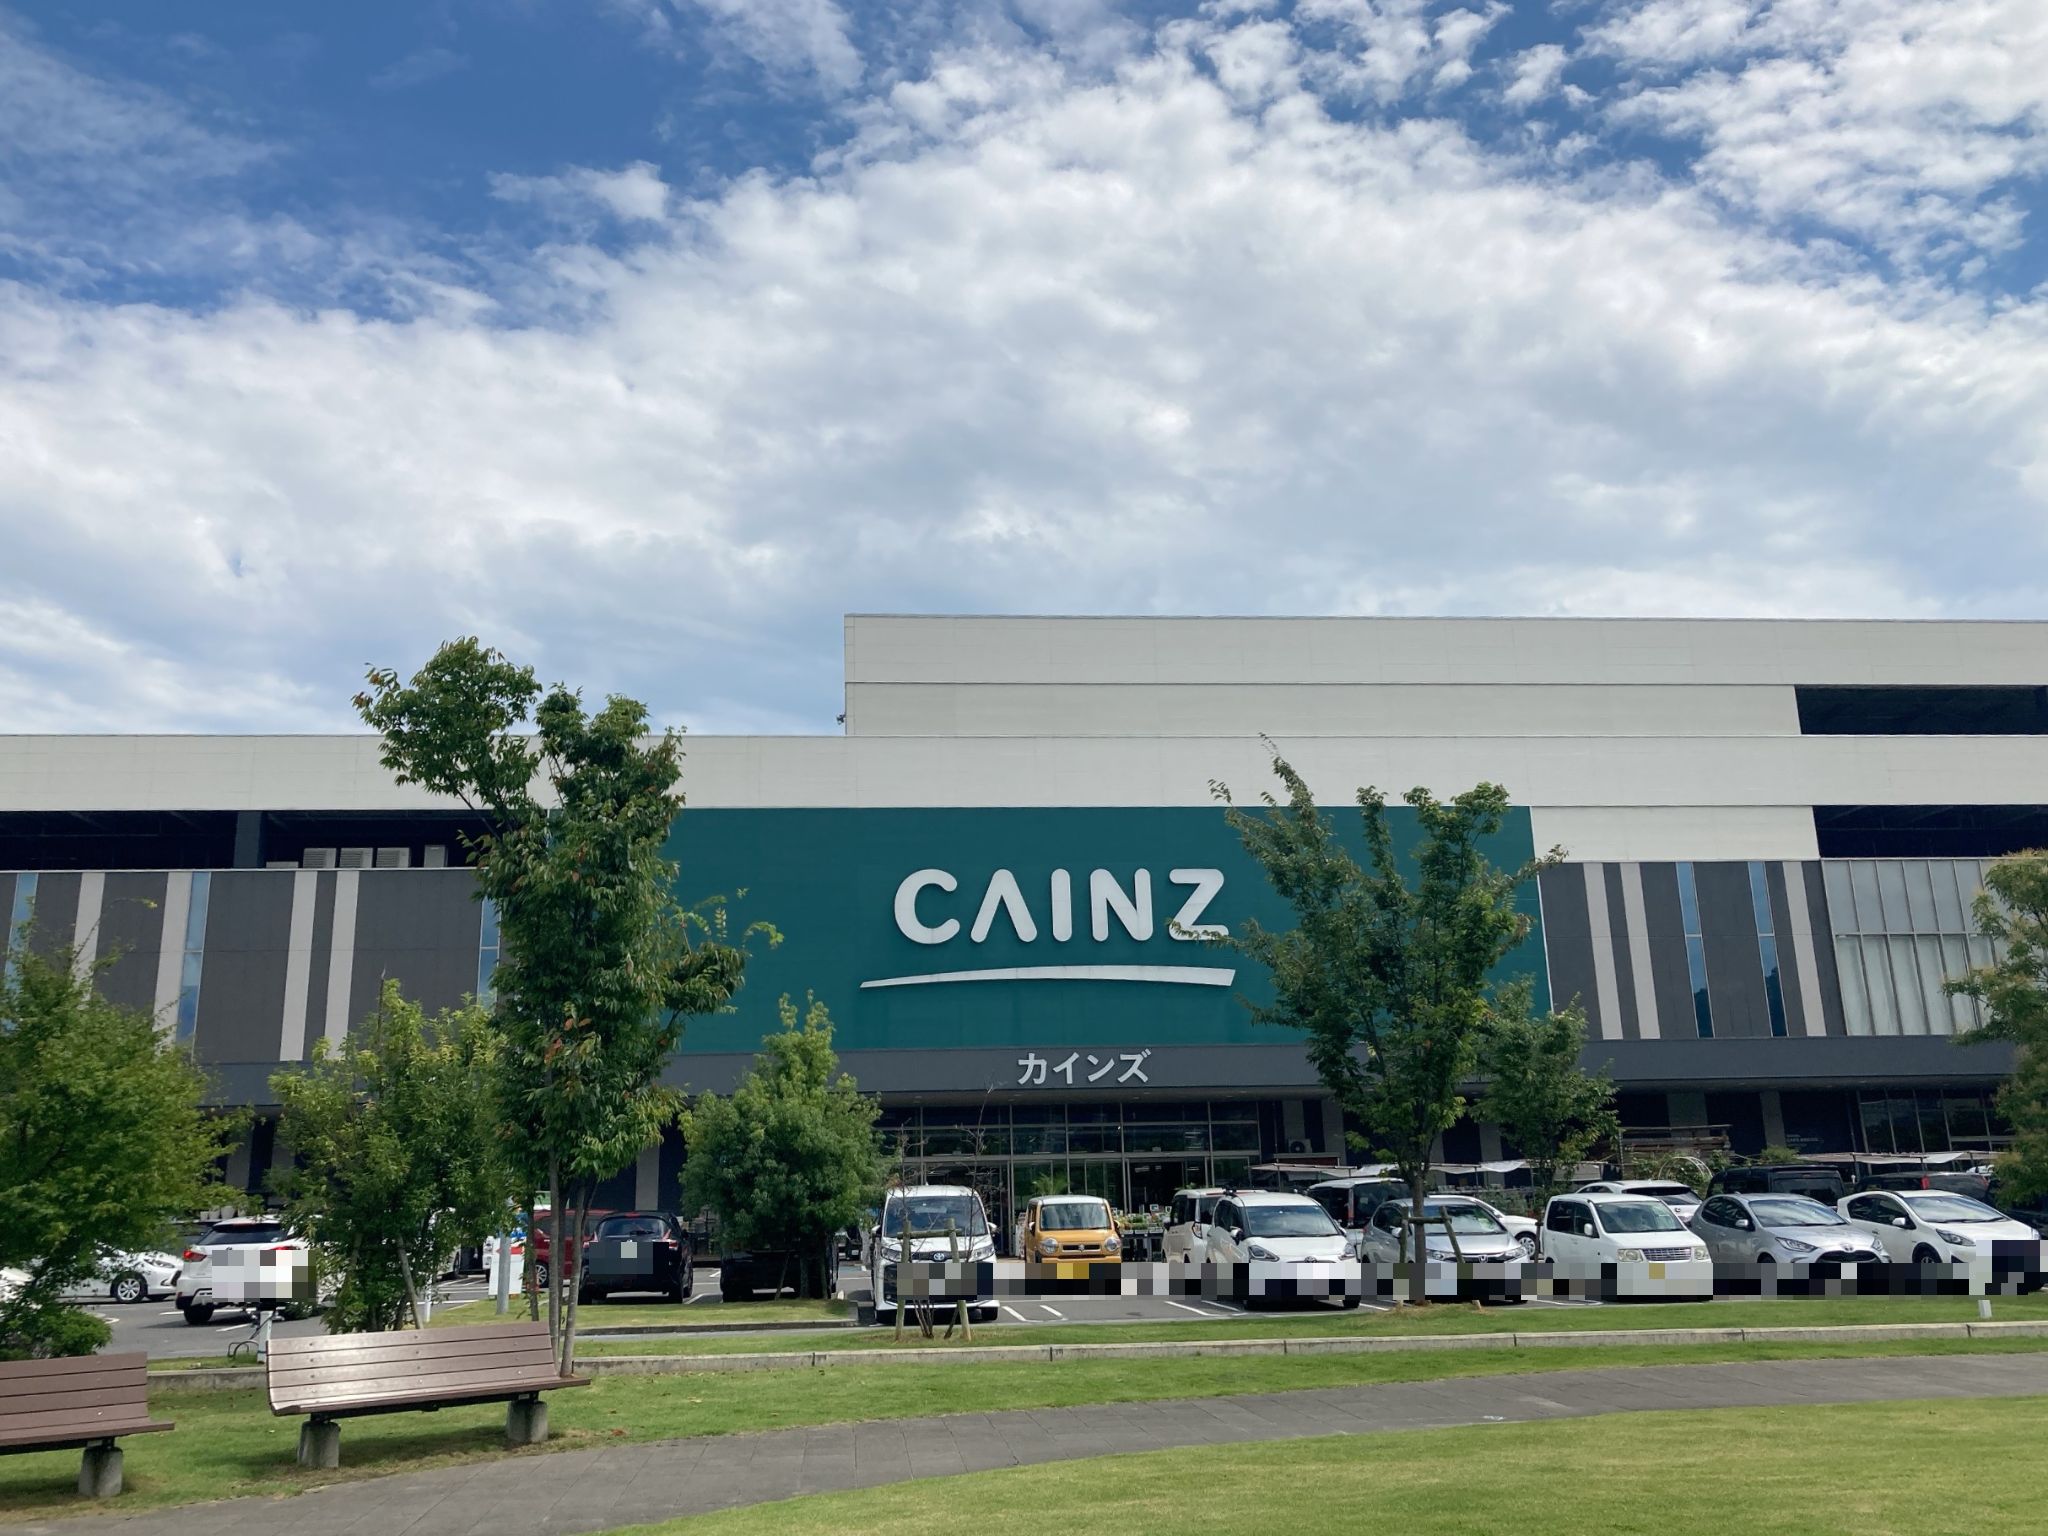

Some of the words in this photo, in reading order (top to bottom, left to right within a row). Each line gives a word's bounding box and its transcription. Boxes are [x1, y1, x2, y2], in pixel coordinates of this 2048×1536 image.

[894, 868, 1230, 944] CAINZ
[1017, 1048, 1151, 1085] カインズ
